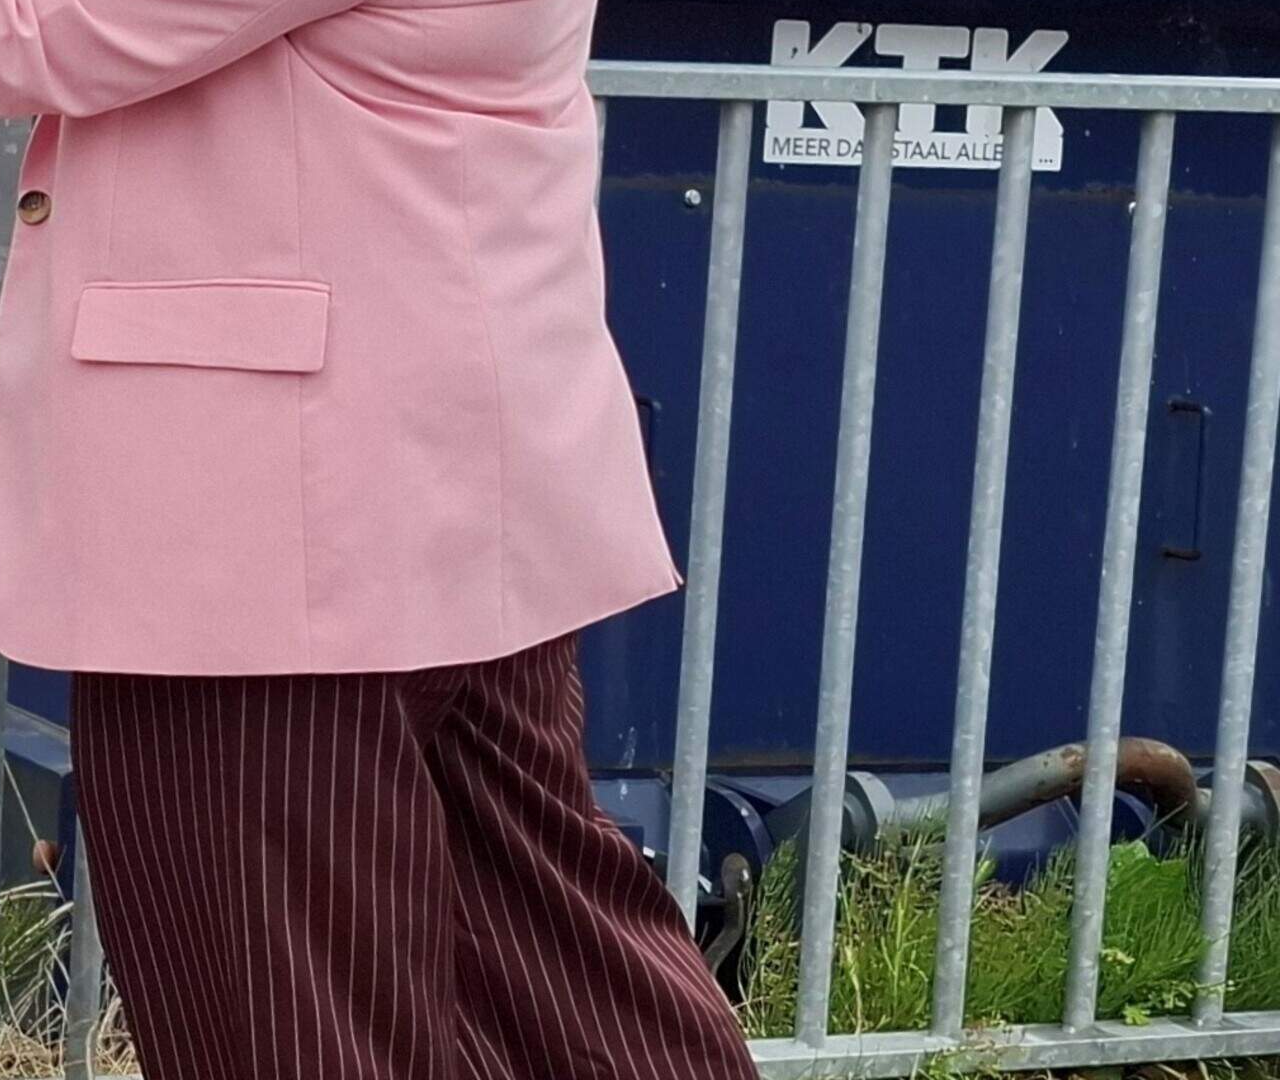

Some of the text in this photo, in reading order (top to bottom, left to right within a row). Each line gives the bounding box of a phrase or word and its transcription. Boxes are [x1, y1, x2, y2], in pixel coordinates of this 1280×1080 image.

[766, 19, 1070, 134] KTK
[771, 137, 831, 157] MEER
[836, 138, 864, 158] DA
[891, 140, 950, 159] STAAL
